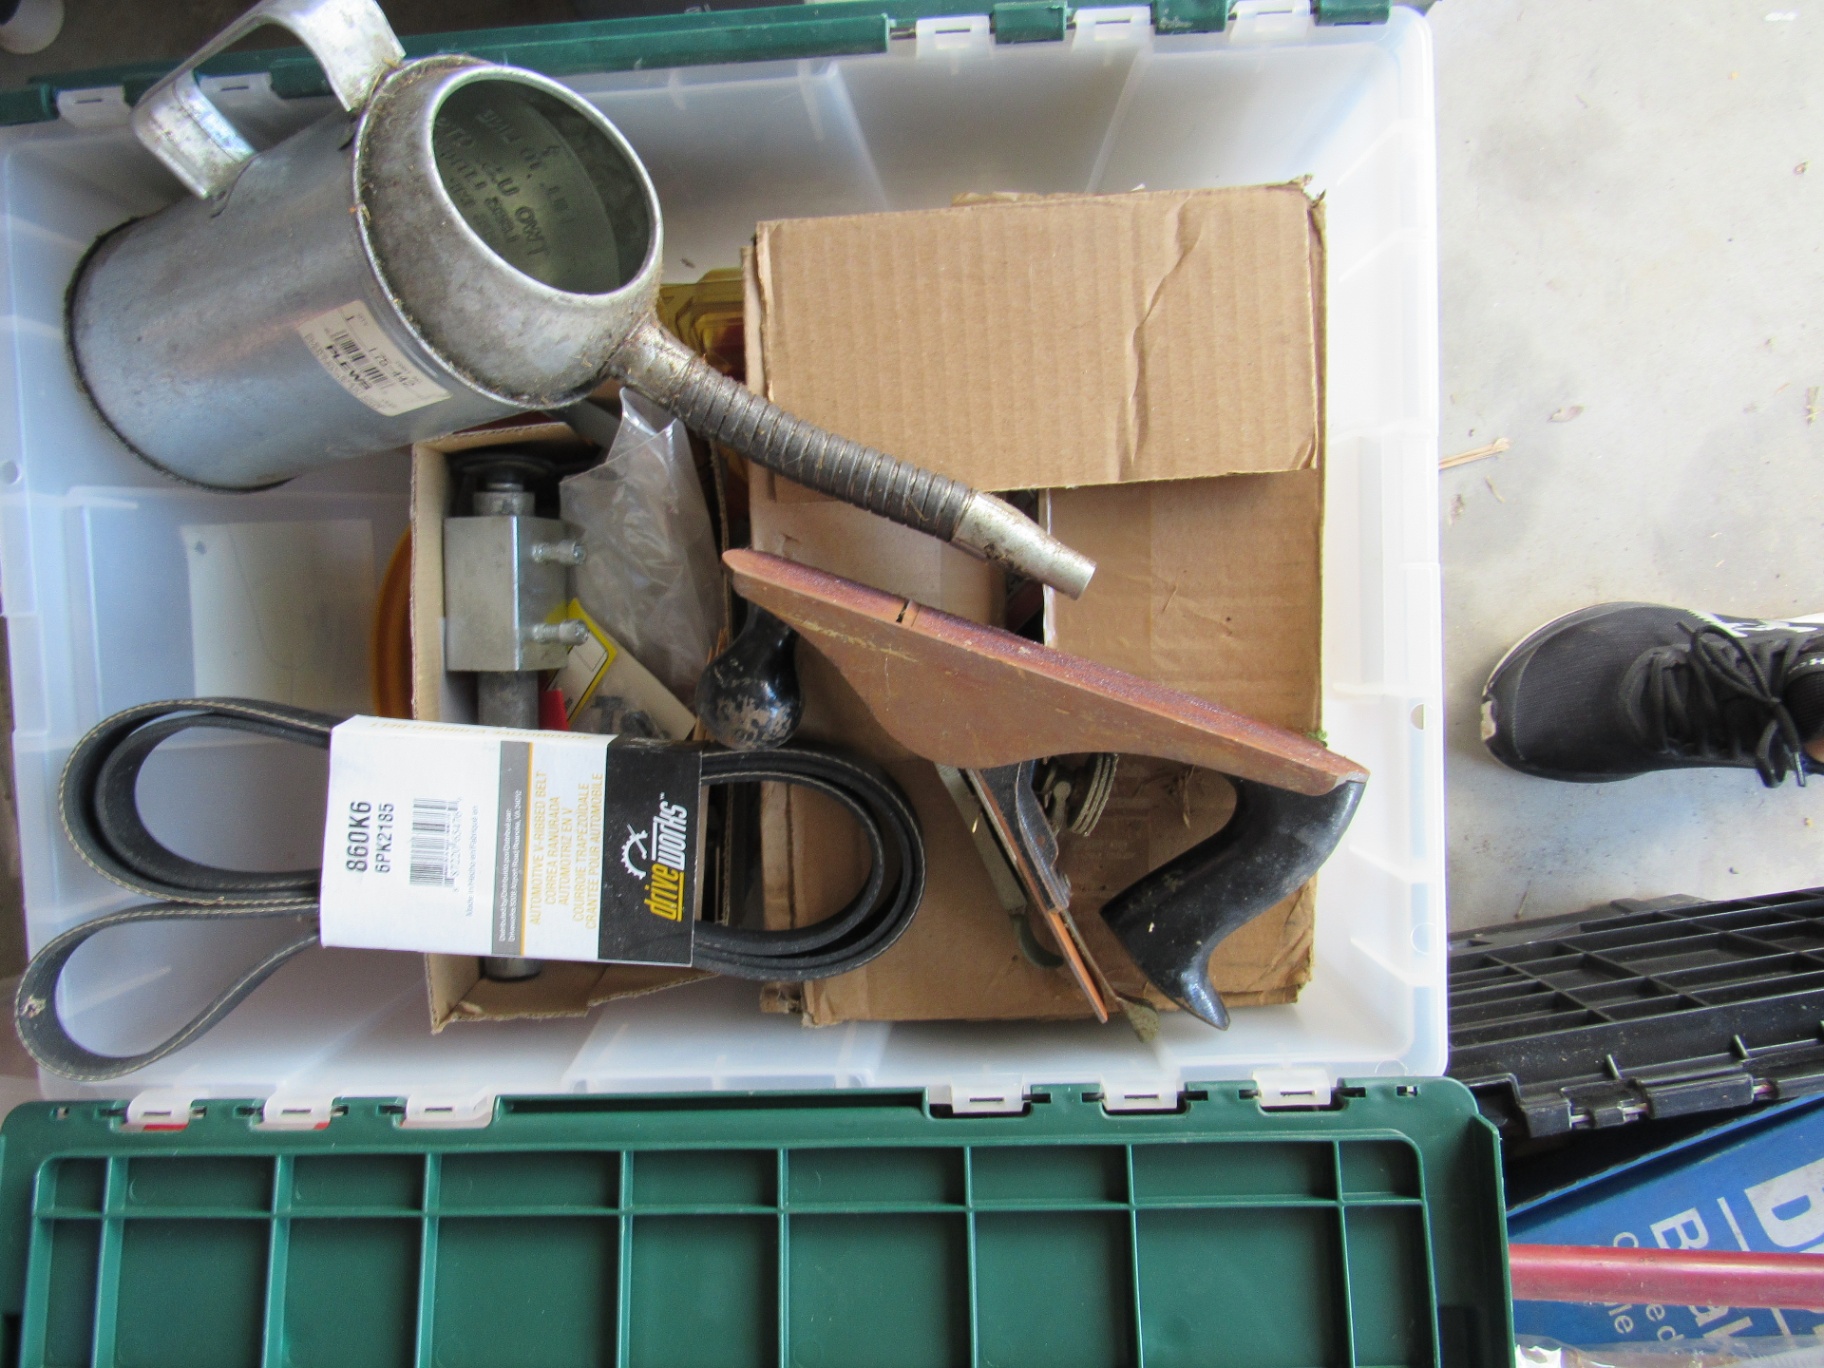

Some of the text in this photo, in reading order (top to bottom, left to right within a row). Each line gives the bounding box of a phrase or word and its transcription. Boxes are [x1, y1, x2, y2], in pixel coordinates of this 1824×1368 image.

[325, 345, 373, 391] PLEWS
[345, 801, 372, 873] 860K6
[374, 802, 395, 874] 6PK2185
[588, 773, 602, 842] AUTOMOBILE
[529, 771, 547, 925] AUTOMOTIVE V-RIBBED BELT
[545, 796, 560, 905] CORREA RANURADA
[558, 806, 573, 905] AUTOMOTRIZ EN V
[588, 846, 600, 876] POUR
[644, 801, 687, 921] driveworks
[572, 867, 586, 922] COURROIE
